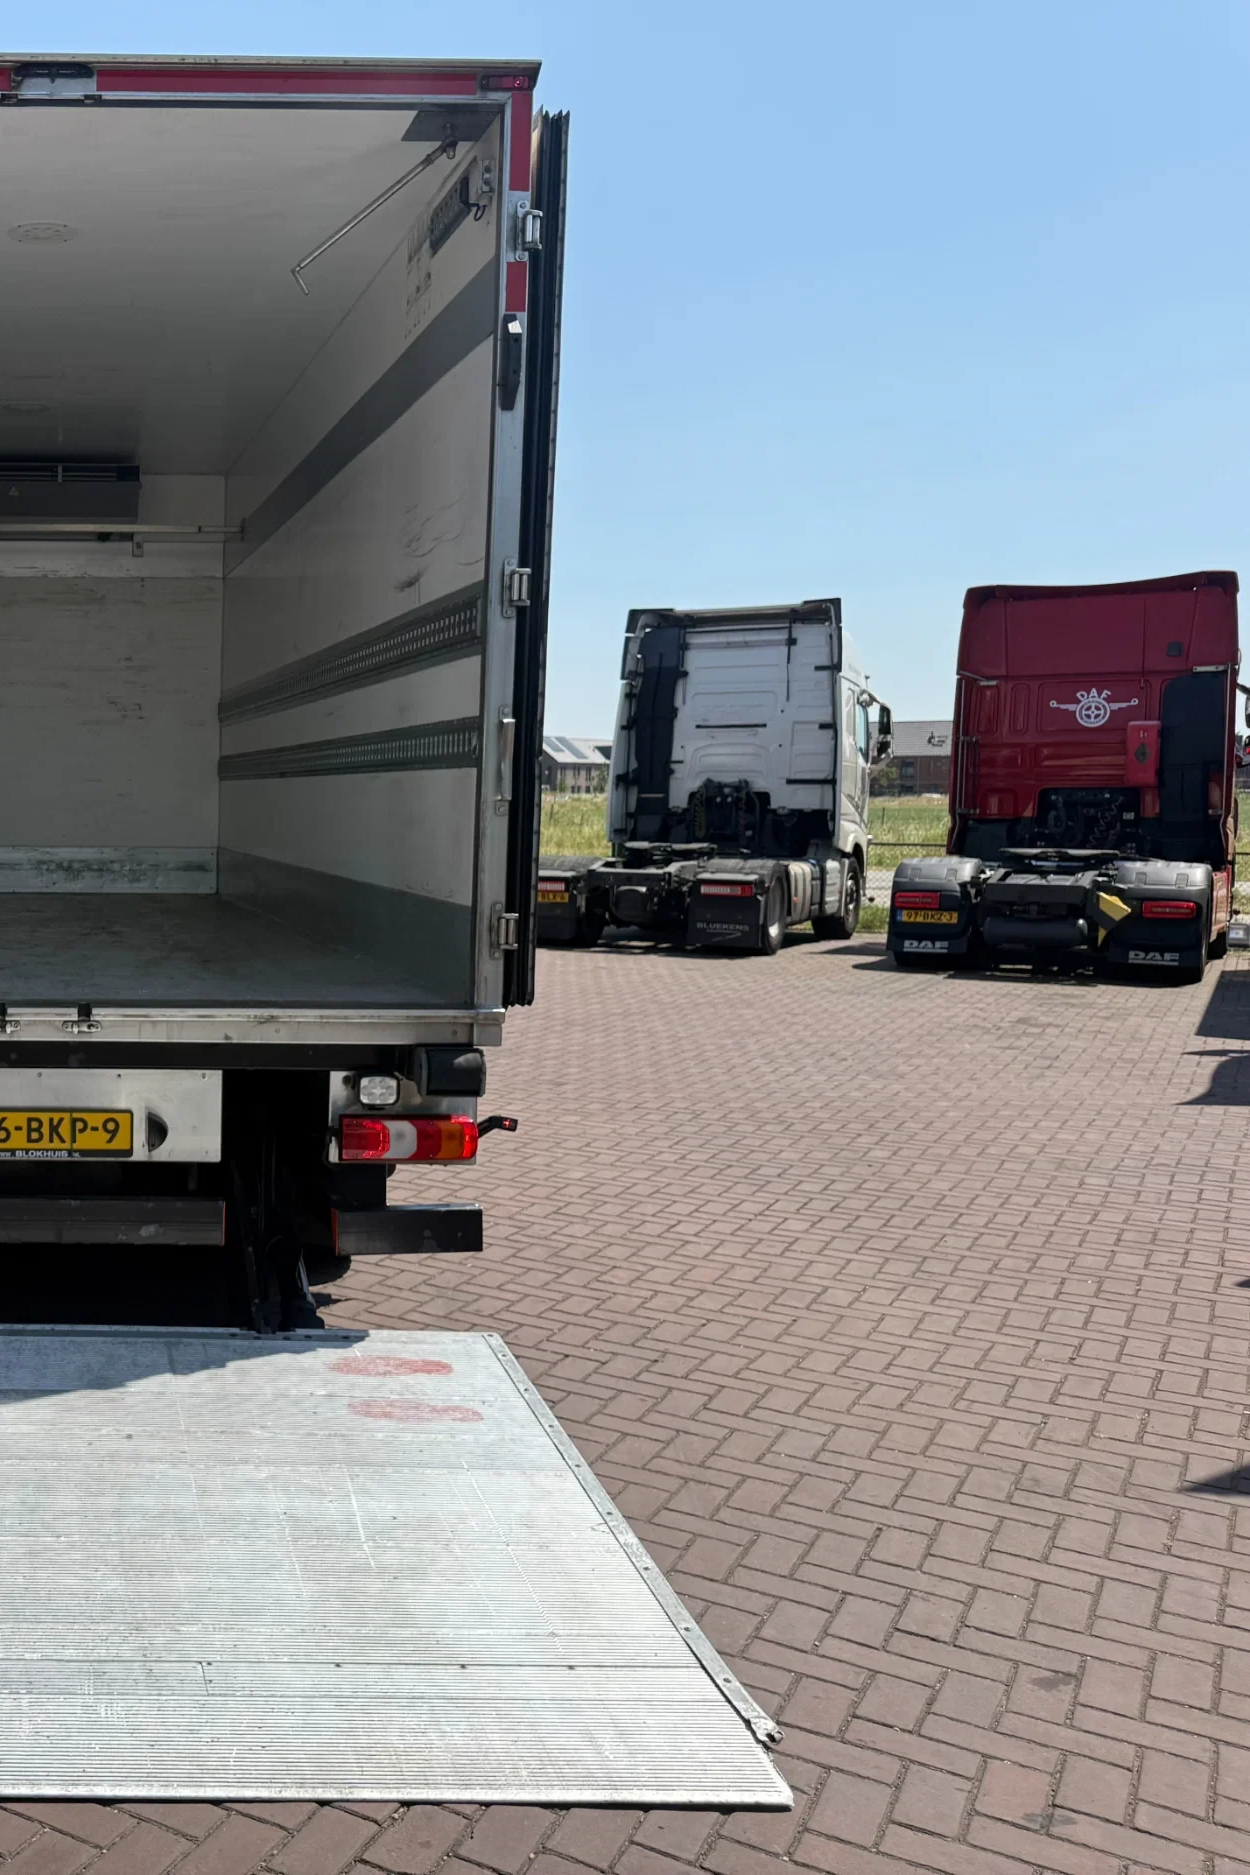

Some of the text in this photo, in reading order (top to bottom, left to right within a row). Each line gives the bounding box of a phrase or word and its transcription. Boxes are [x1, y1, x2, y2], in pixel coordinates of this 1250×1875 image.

[1076, 688, 1112, 702] DAF
[696, 921, 751, 932] BLUEKENS
[903, 939, 949, 949] DAF
[1128, 950, 1180, 961] DAF
